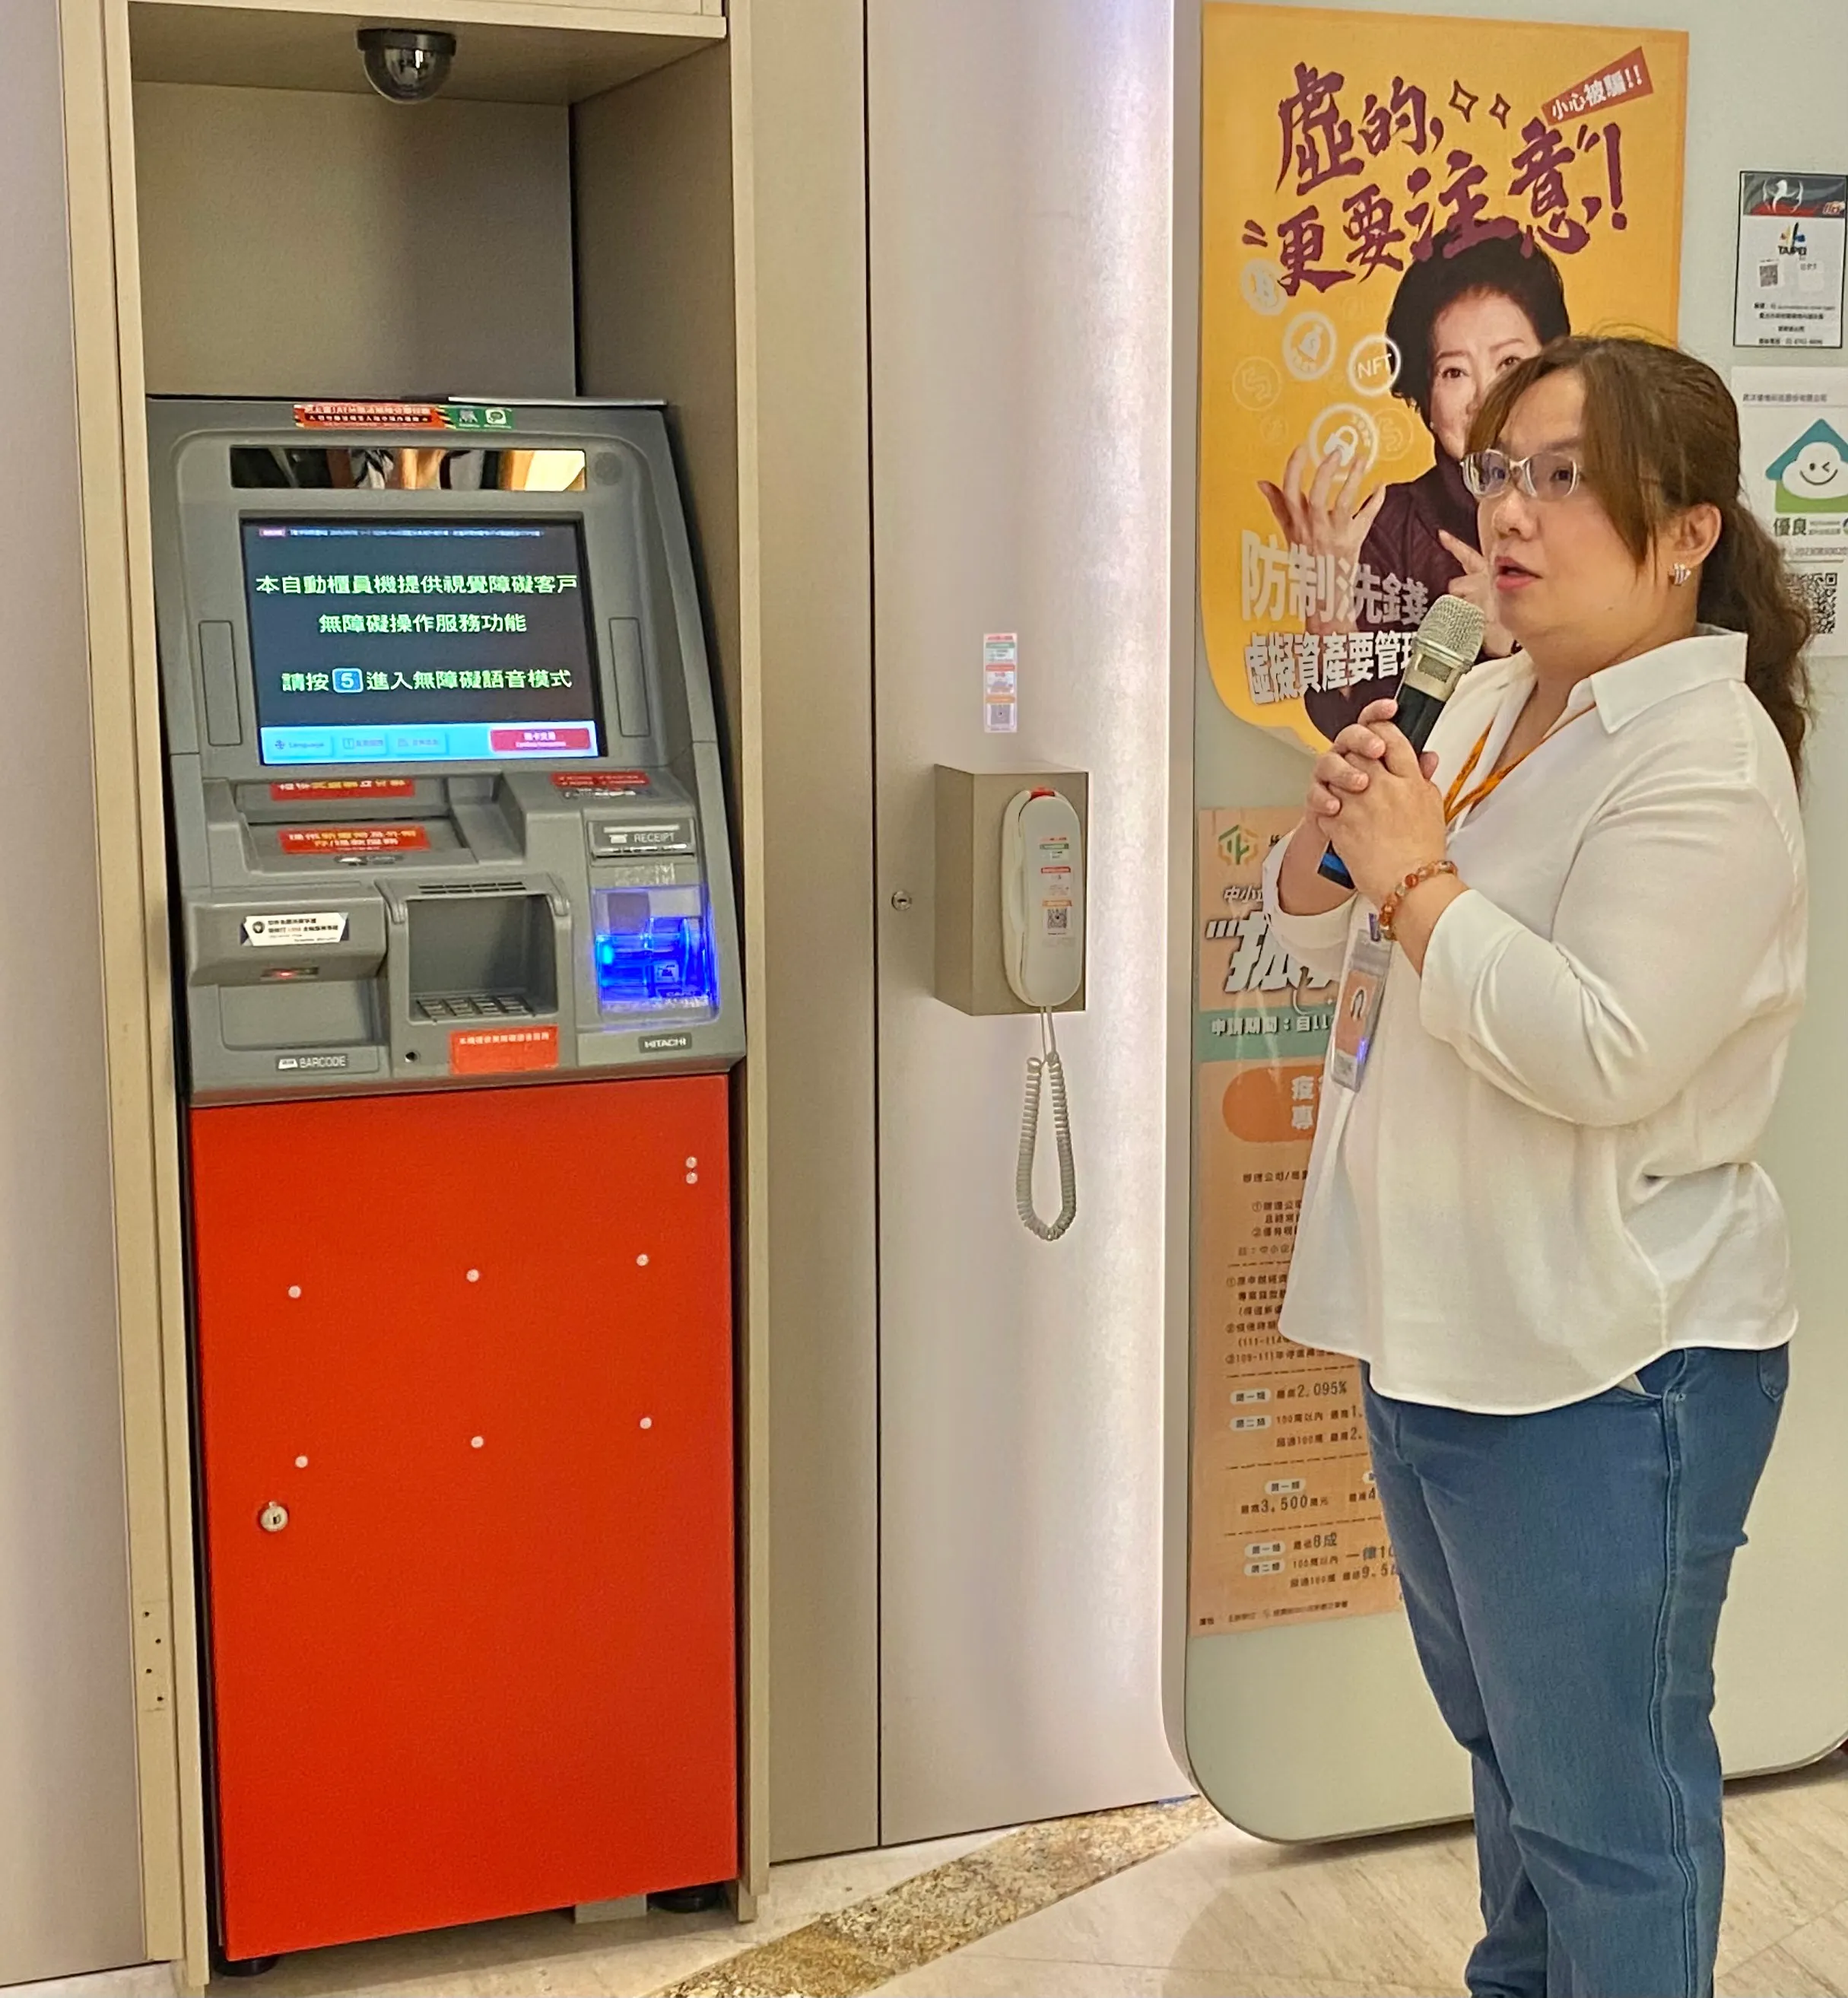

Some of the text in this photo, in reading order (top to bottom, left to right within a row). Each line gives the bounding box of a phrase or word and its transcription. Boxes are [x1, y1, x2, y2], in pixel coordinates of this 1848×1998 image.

[1551, 65, 1643, 122] 小心被騙!!
[1355, 353, 1392, 379] NFT
[1774, 517, 1807, 536] 優良
[1241, 530, 1430, 625] 防制洗錢
[319, 614, 528, 634] 無障礙操作服務功能
[634, 832, 675, 843] RECEIPT
[644, 1037, 687, 1049] HITACHI
[299, 1055, 347, 1069] BARCODE
